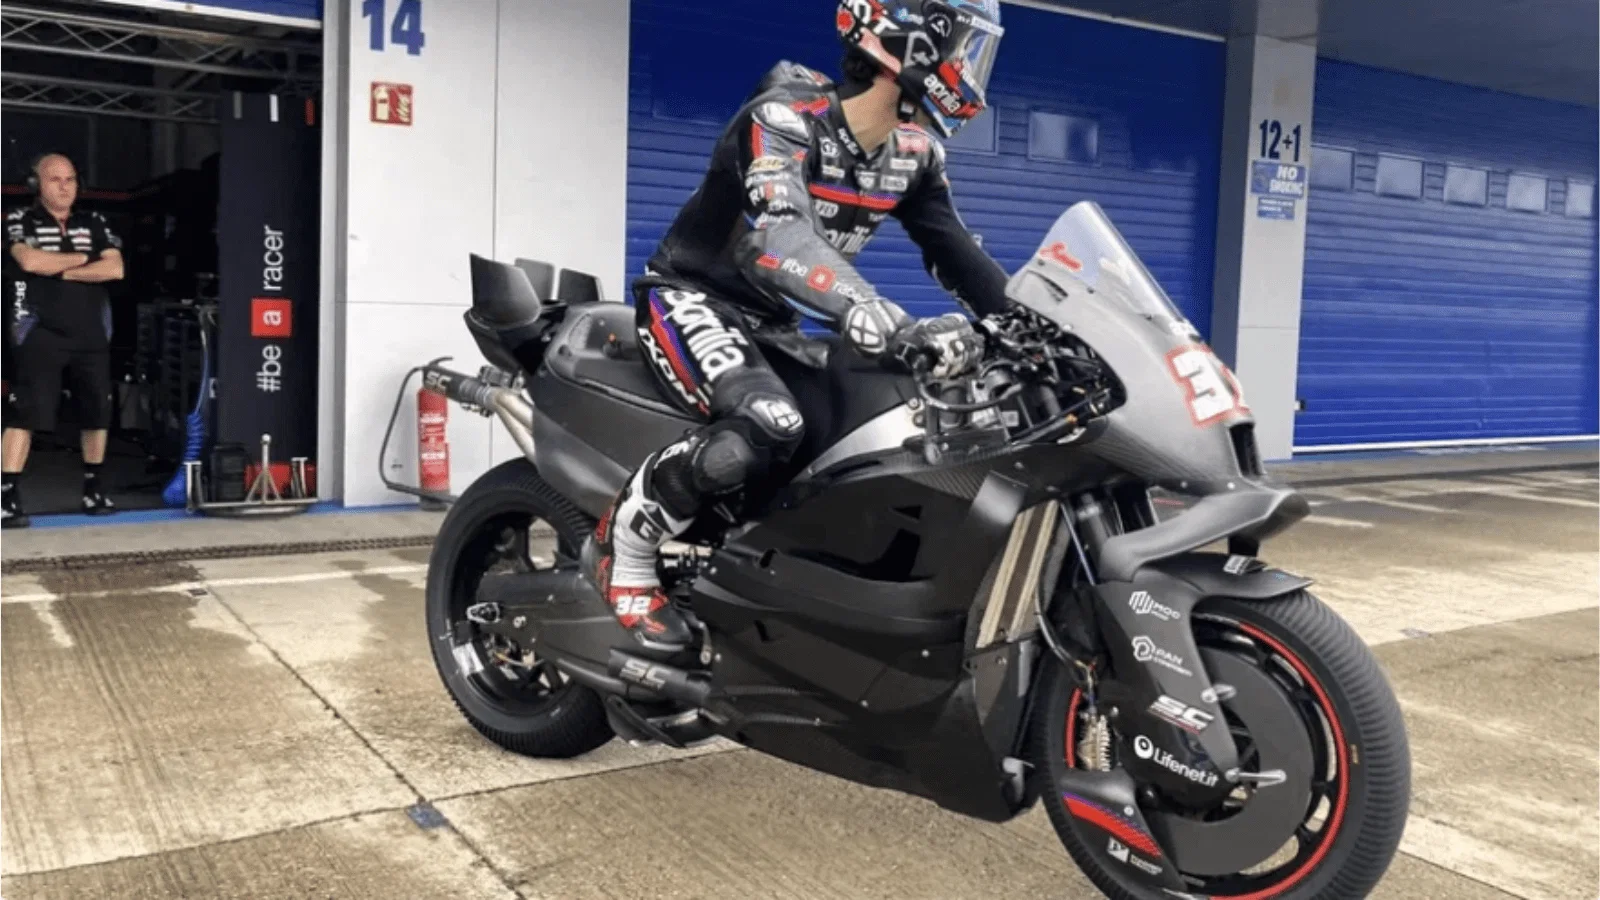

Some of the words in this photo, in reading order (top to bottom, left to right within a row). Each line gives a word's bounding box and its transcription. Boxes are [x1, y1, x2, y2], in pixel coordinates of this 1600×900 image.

[362, 0, 425, 56] 14
[923, 73, 962, 114] aprilia
[1259, 119, 1301, 162] 12+1
[1276, 164, 1298, 181] NO
[263, 224, 284, 291] racer
[781, 258, 808, 277] #be
[262, 309, 282, 326] a
[662, 290, 749, 382] aprilia
[256, 344, 282, 392] #be
[426, 371, 452, 392] SC
[615, 595, 651, 615] 32
[621, 659, 672, 684] SC
[1150, 694, 1215, 731] SC
[1153, 747, 1219, 788] Lifenet.it
